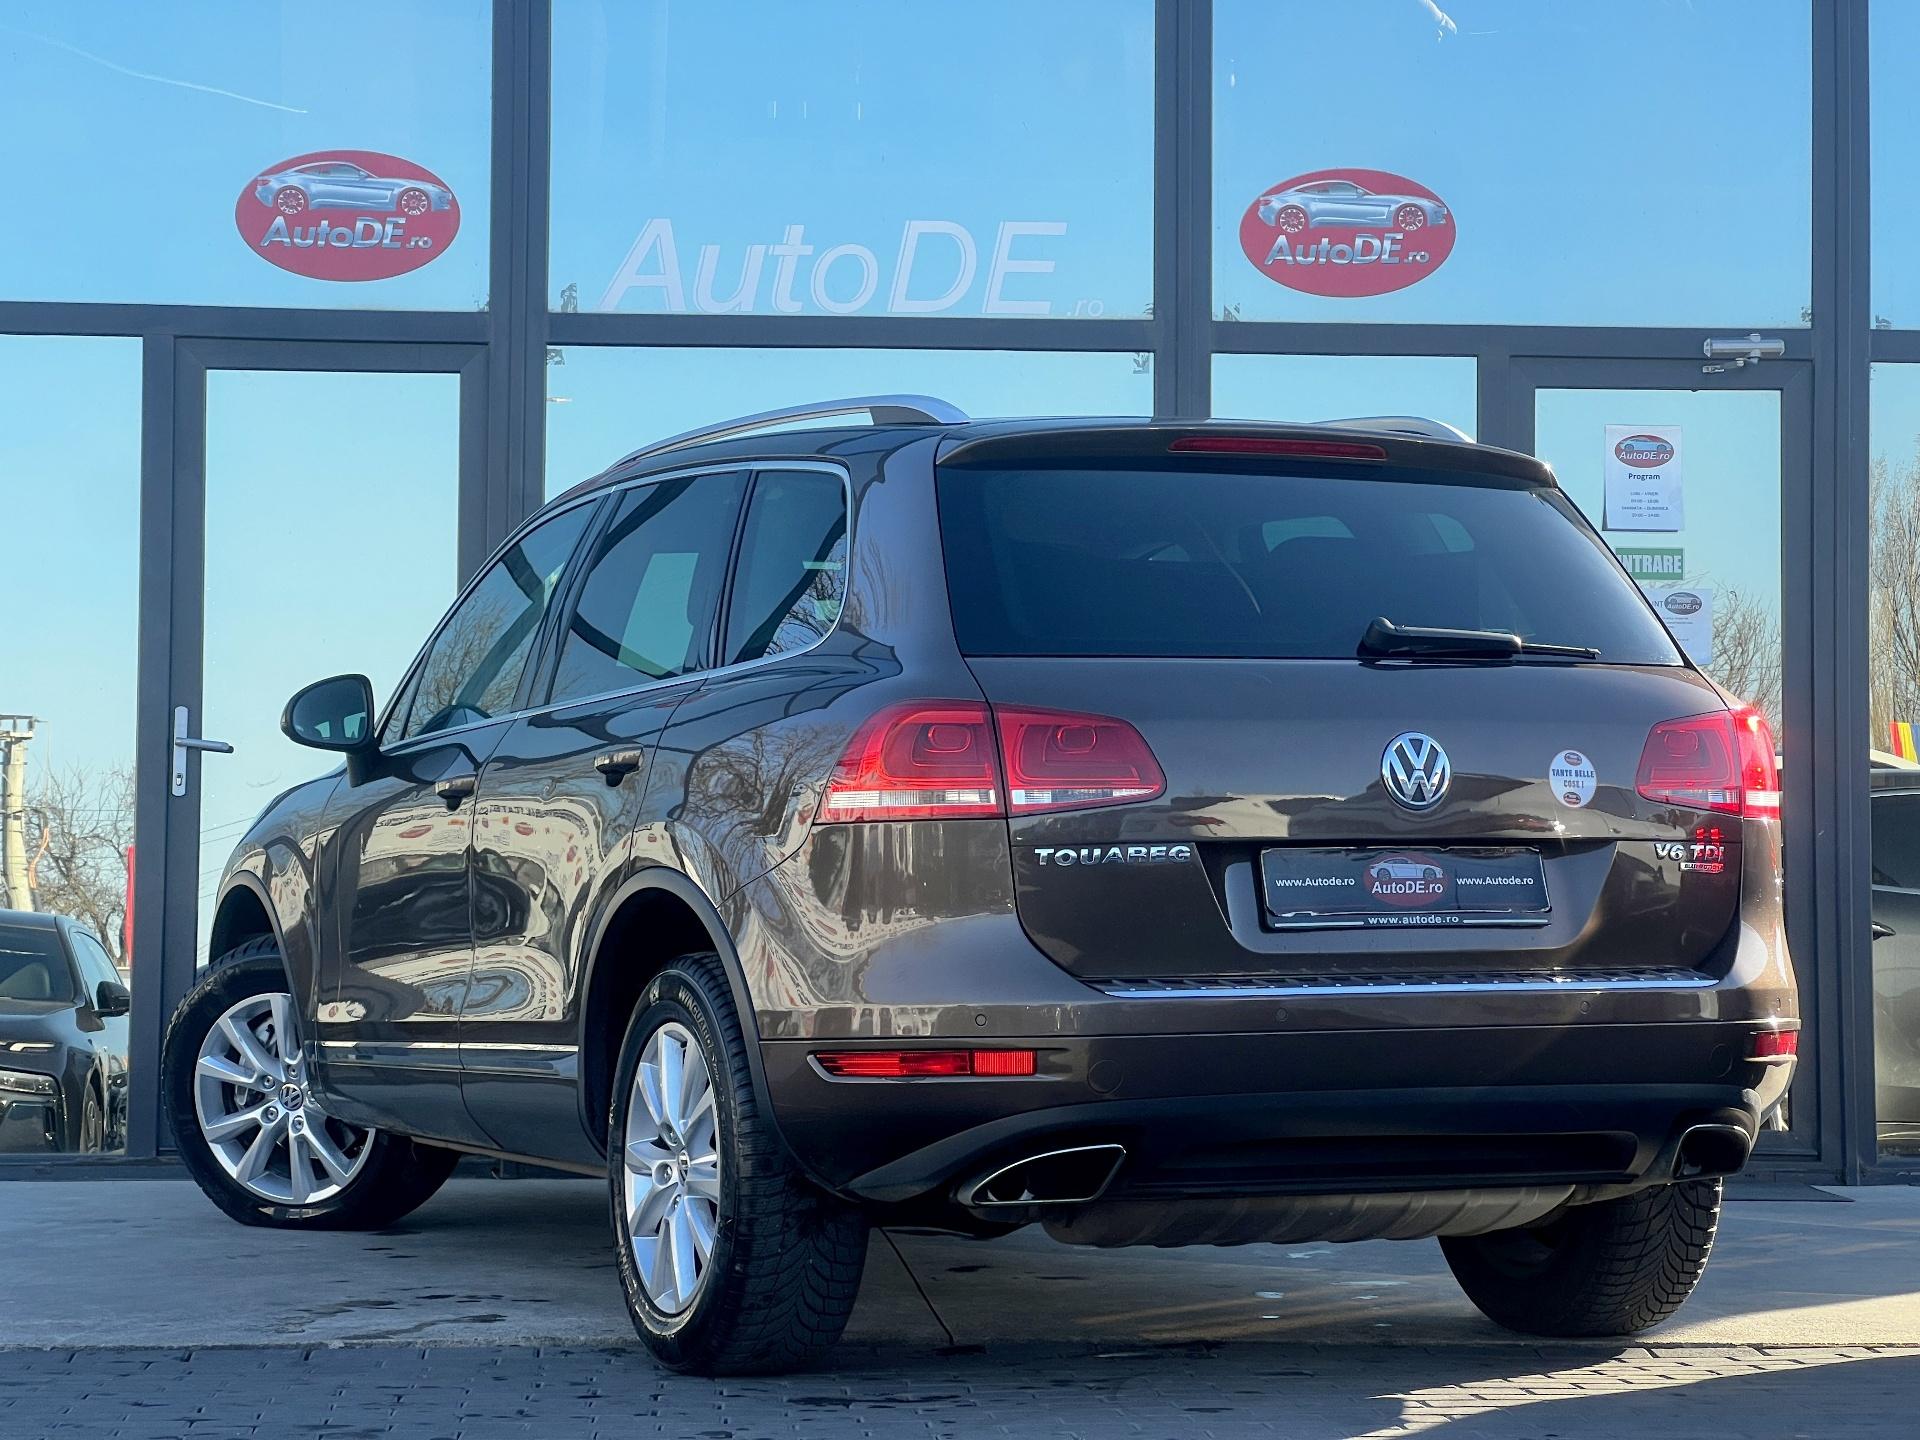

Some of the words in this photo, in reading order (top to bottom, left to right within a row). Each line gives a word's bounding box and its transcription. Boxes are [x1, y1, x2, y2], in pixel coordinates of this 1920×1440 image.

[1628, 473, 1661, 481] Program
[1552, 769, 1573, 777] TANTE
[1574, 769, 1595, 778] BELLE
[1034, 844, 1191, 866] TOUAREG
[1654, 843, 1685, 861] V6
[1690, 844, 1724, 862] TDI
[1276, 876, 1355, 887] www.Autode.ro
[1371, 880, 1444, 894] AutoDE.ro
[1456, 876, 1534, 886] www.Autode.ro
[1368, 915, 1459, 925] www.autode.ro
